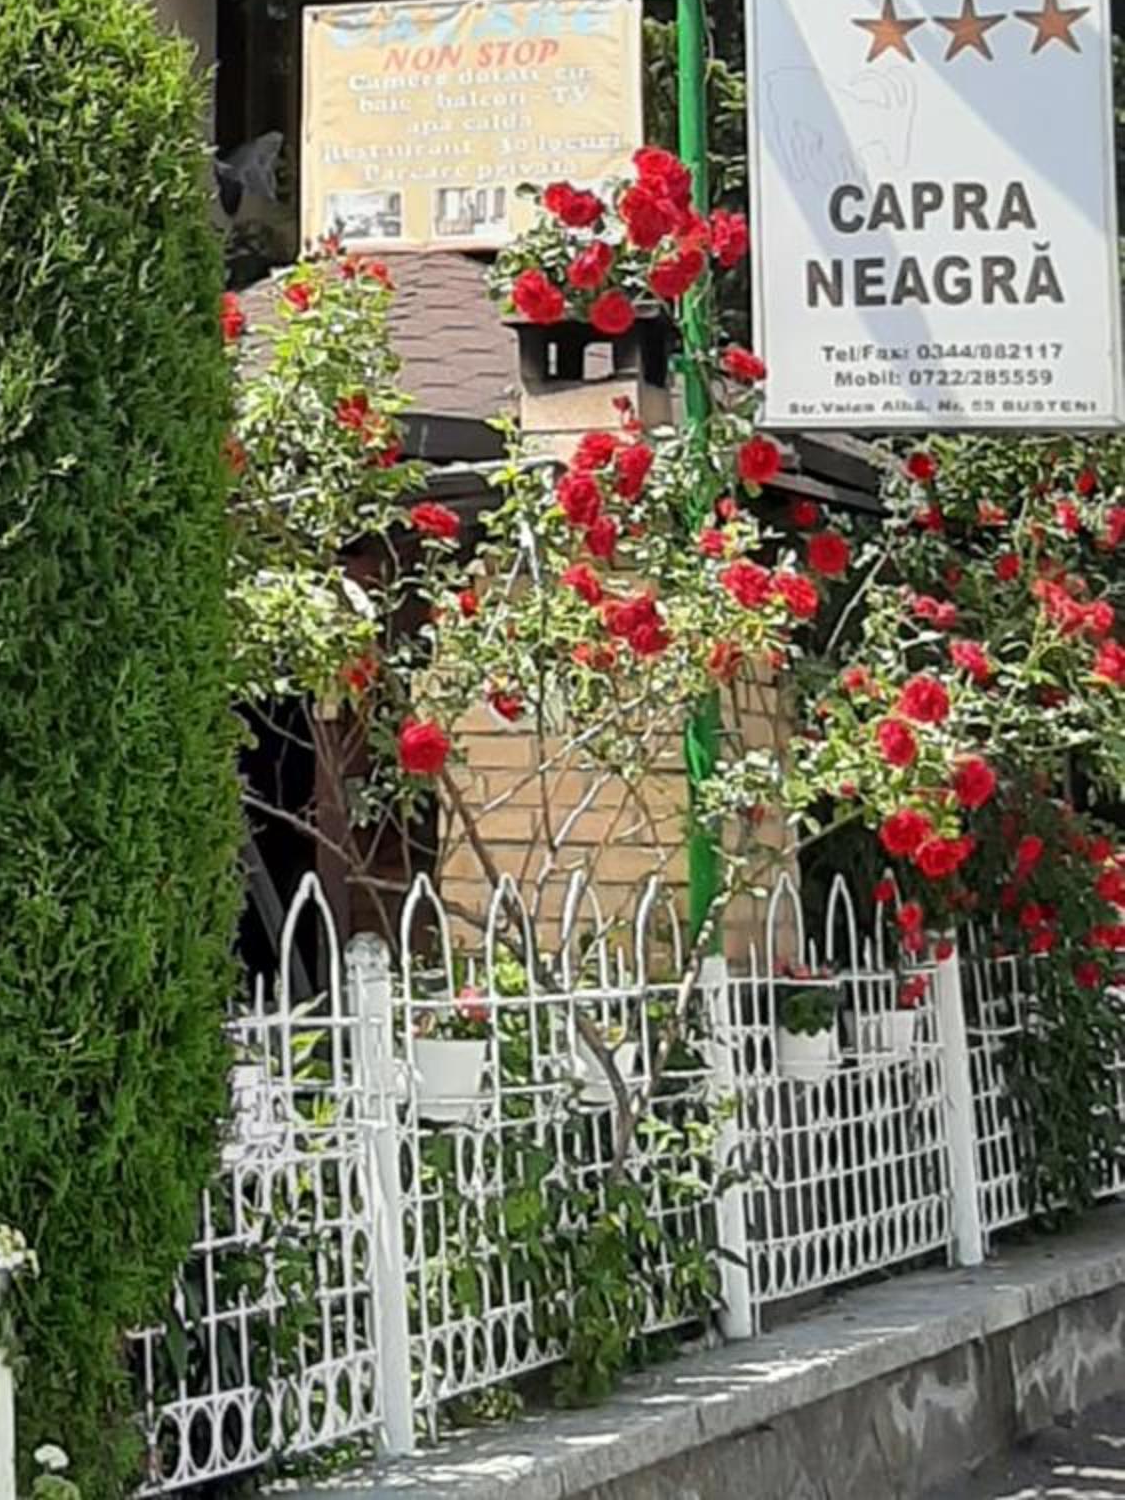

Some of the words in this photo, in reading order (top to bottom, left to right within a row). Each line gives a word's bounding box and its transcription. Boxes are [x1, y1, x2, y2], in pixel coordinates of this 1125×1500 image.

[383, 44, 464, 72] NON
[475, 38, 561, 69] STOP
[828, 181, 1037, 234] CAPRA
[806, 240, 1065, 307] NEAGRĂ
[821, 344, 909, 362] Tel/Fax:
[834, 370, 901, 387] Mobil:
[909, 369, 1053, 386] 0722/285559
